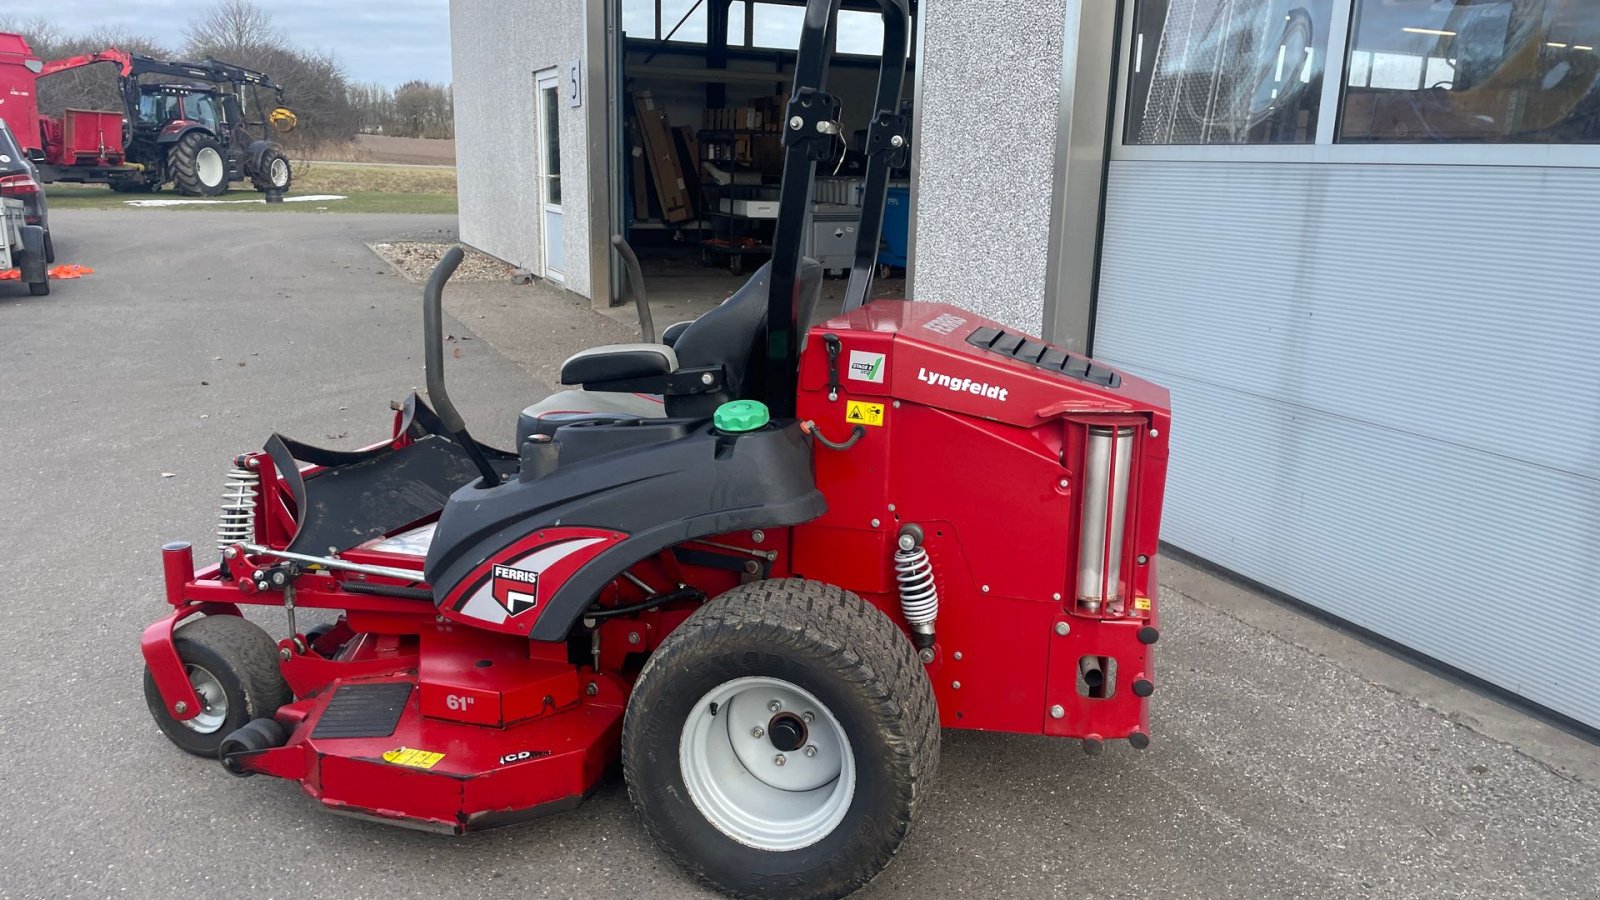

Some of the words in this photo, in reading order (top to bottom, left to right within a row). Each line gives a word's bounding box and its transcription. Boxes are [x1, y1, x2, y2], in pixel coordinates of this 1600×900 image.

[571, 67, 577, 99] 5
[918, 368, 1008, 401] Lyngfeldt
[495, 566, 536, 583] FERRIS
[446, 694, 474, 711] 61"
